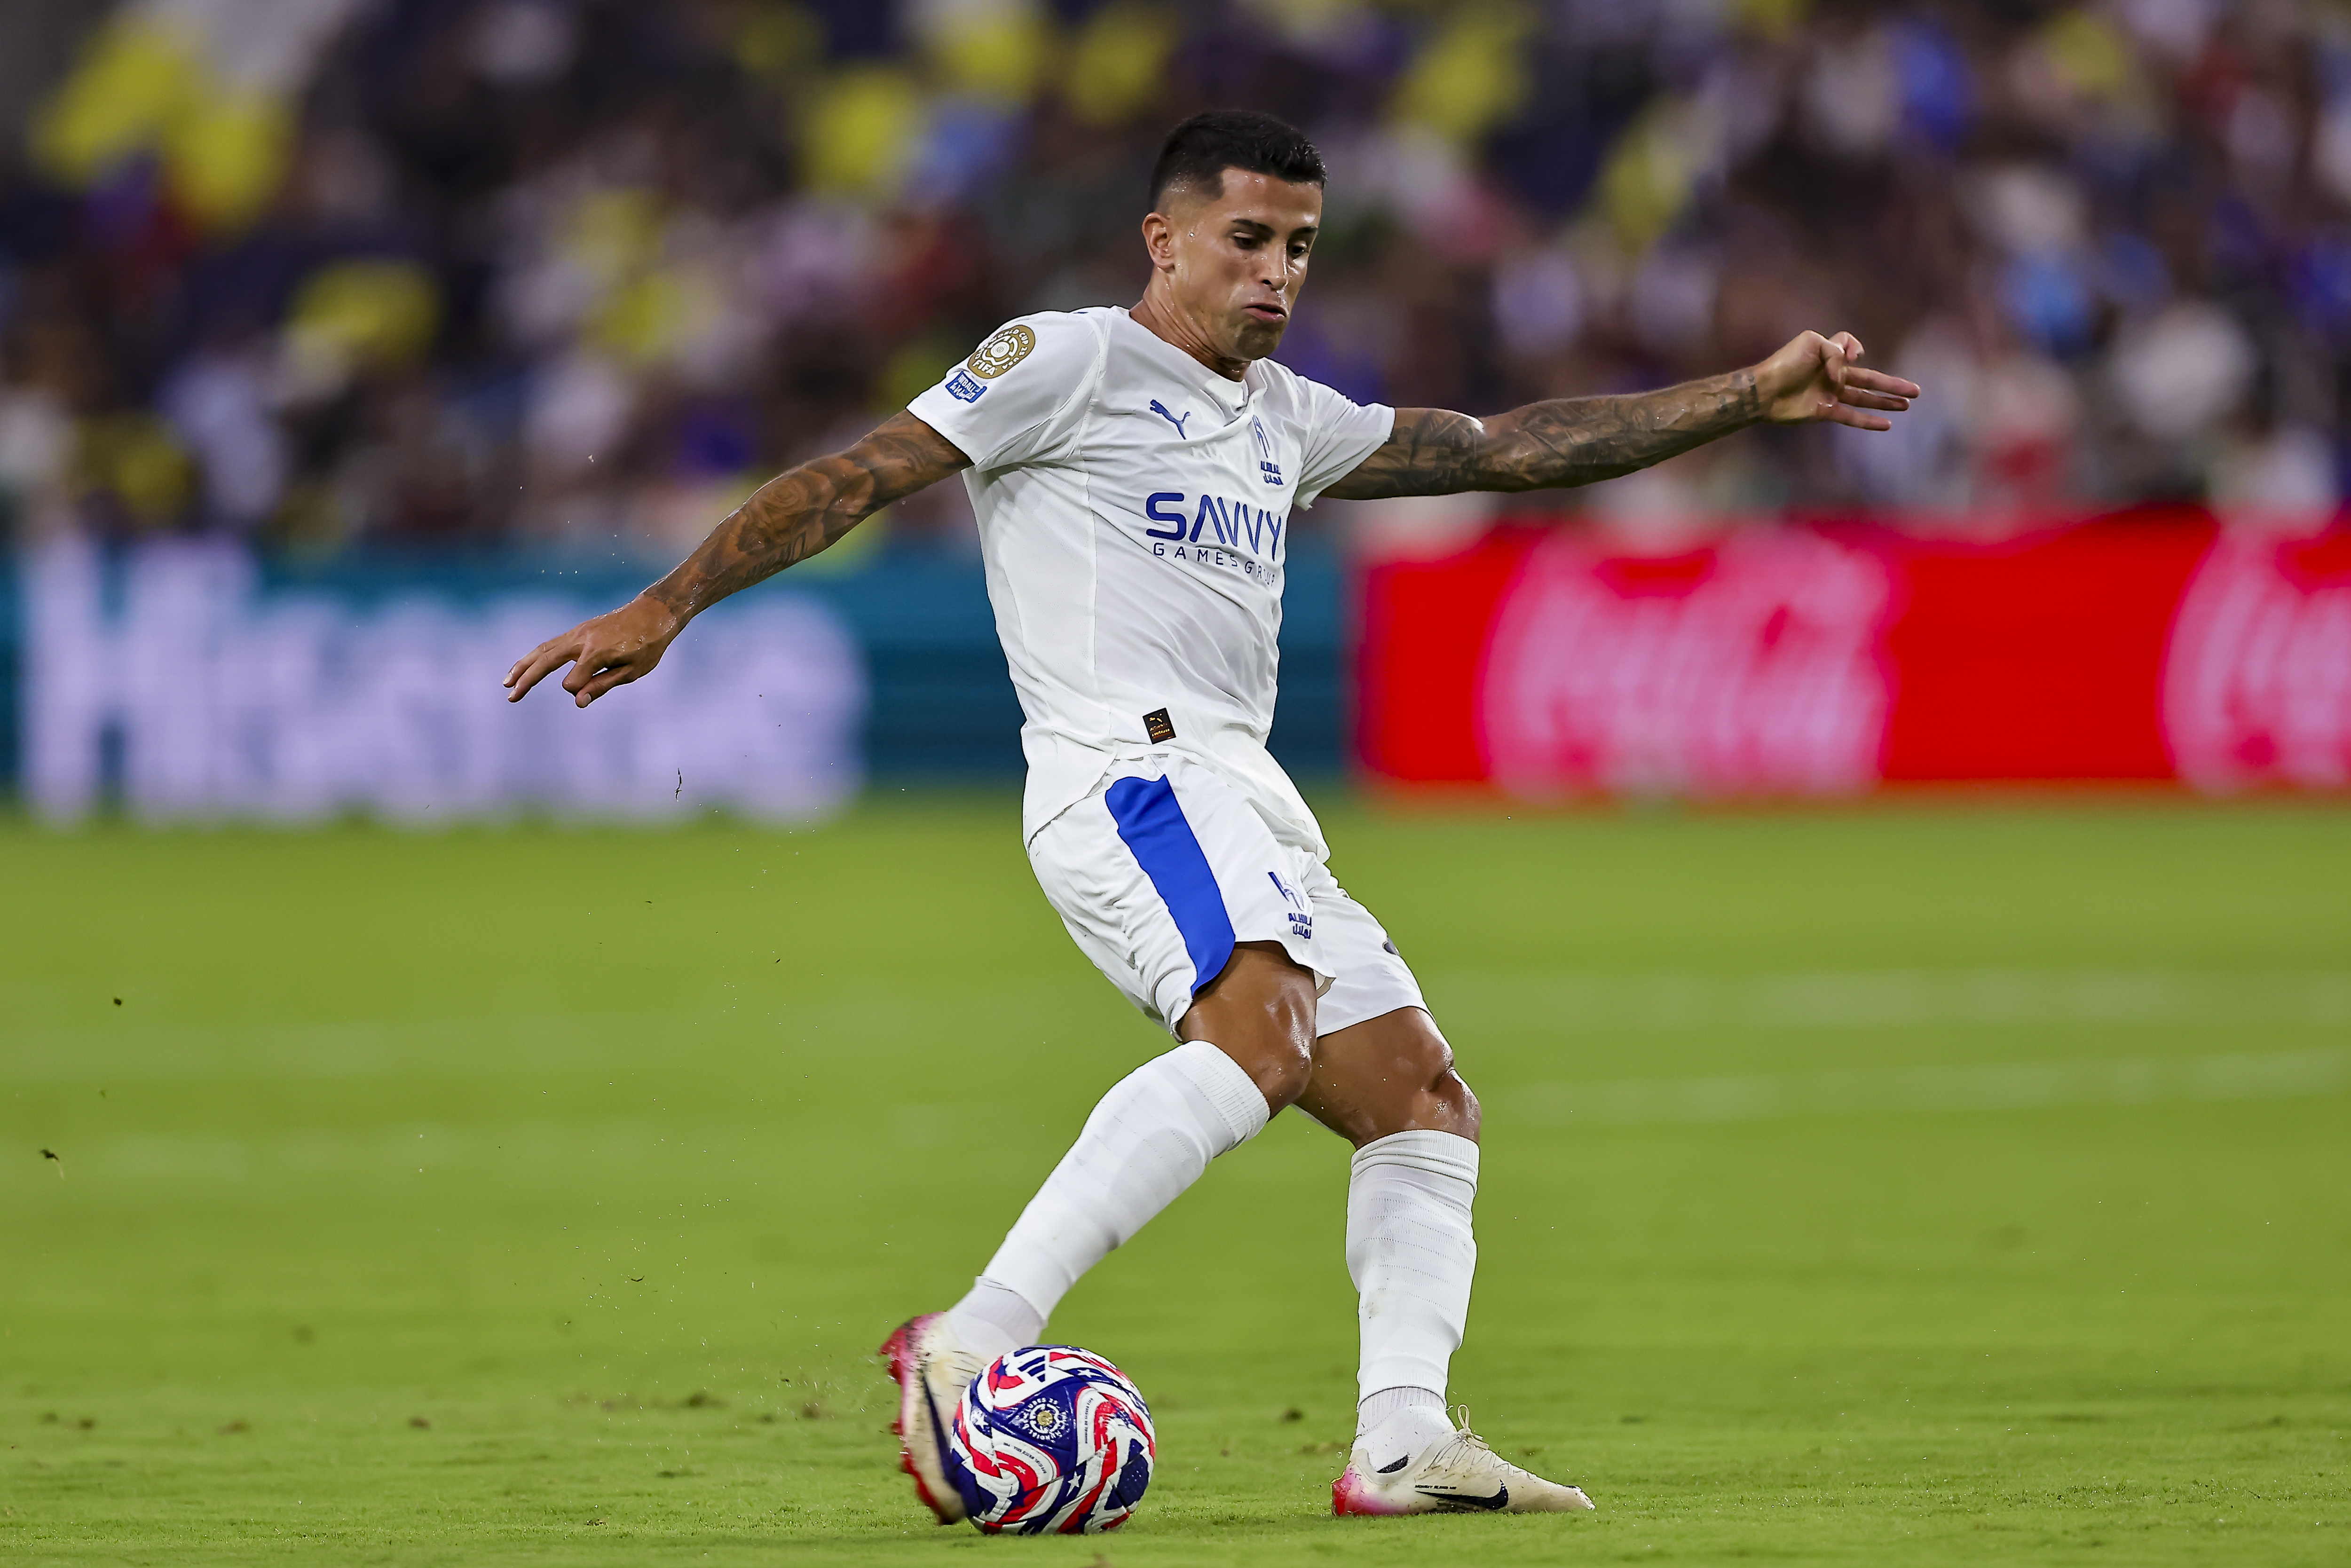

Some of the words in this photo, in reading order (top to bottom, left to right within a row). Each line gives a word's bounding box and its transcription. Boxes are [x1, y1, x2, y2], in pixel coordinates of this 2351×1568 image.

[1018, 332, 1029, 345] CUP
[1018, 346, 1028, 356] 25
[972, 359, 996, 376] FIFA
[1002, 357, 1020, 370] USA
[1146, 492, 1281, 562] SAVVY
[1153, 543, 1238, 567] GAMES
